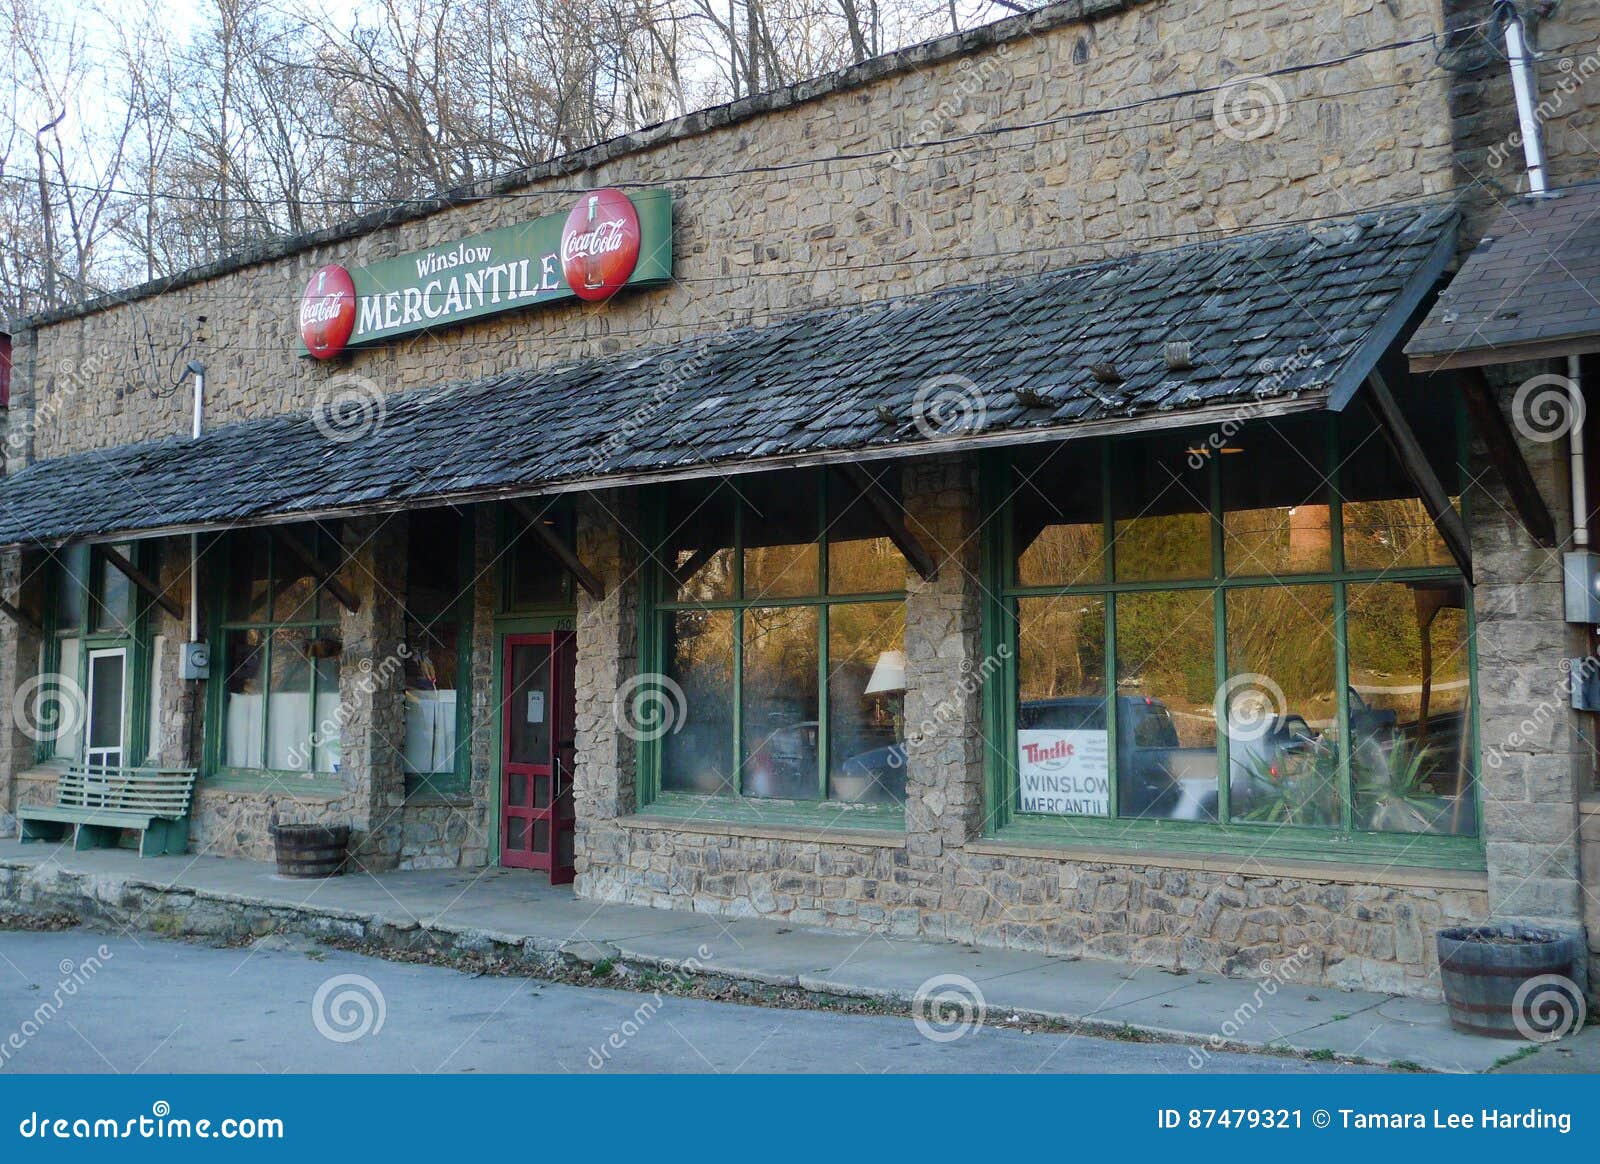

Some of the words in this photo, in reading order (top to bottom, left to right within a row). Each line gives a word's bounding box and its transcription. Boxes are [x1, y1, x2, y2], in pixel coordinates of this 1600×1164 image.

[416, 243, 492, 280] Winslow
[357, 253, 561, 336] MERCANTILE
[1024, 775, 1109, 794] WINSLOW
